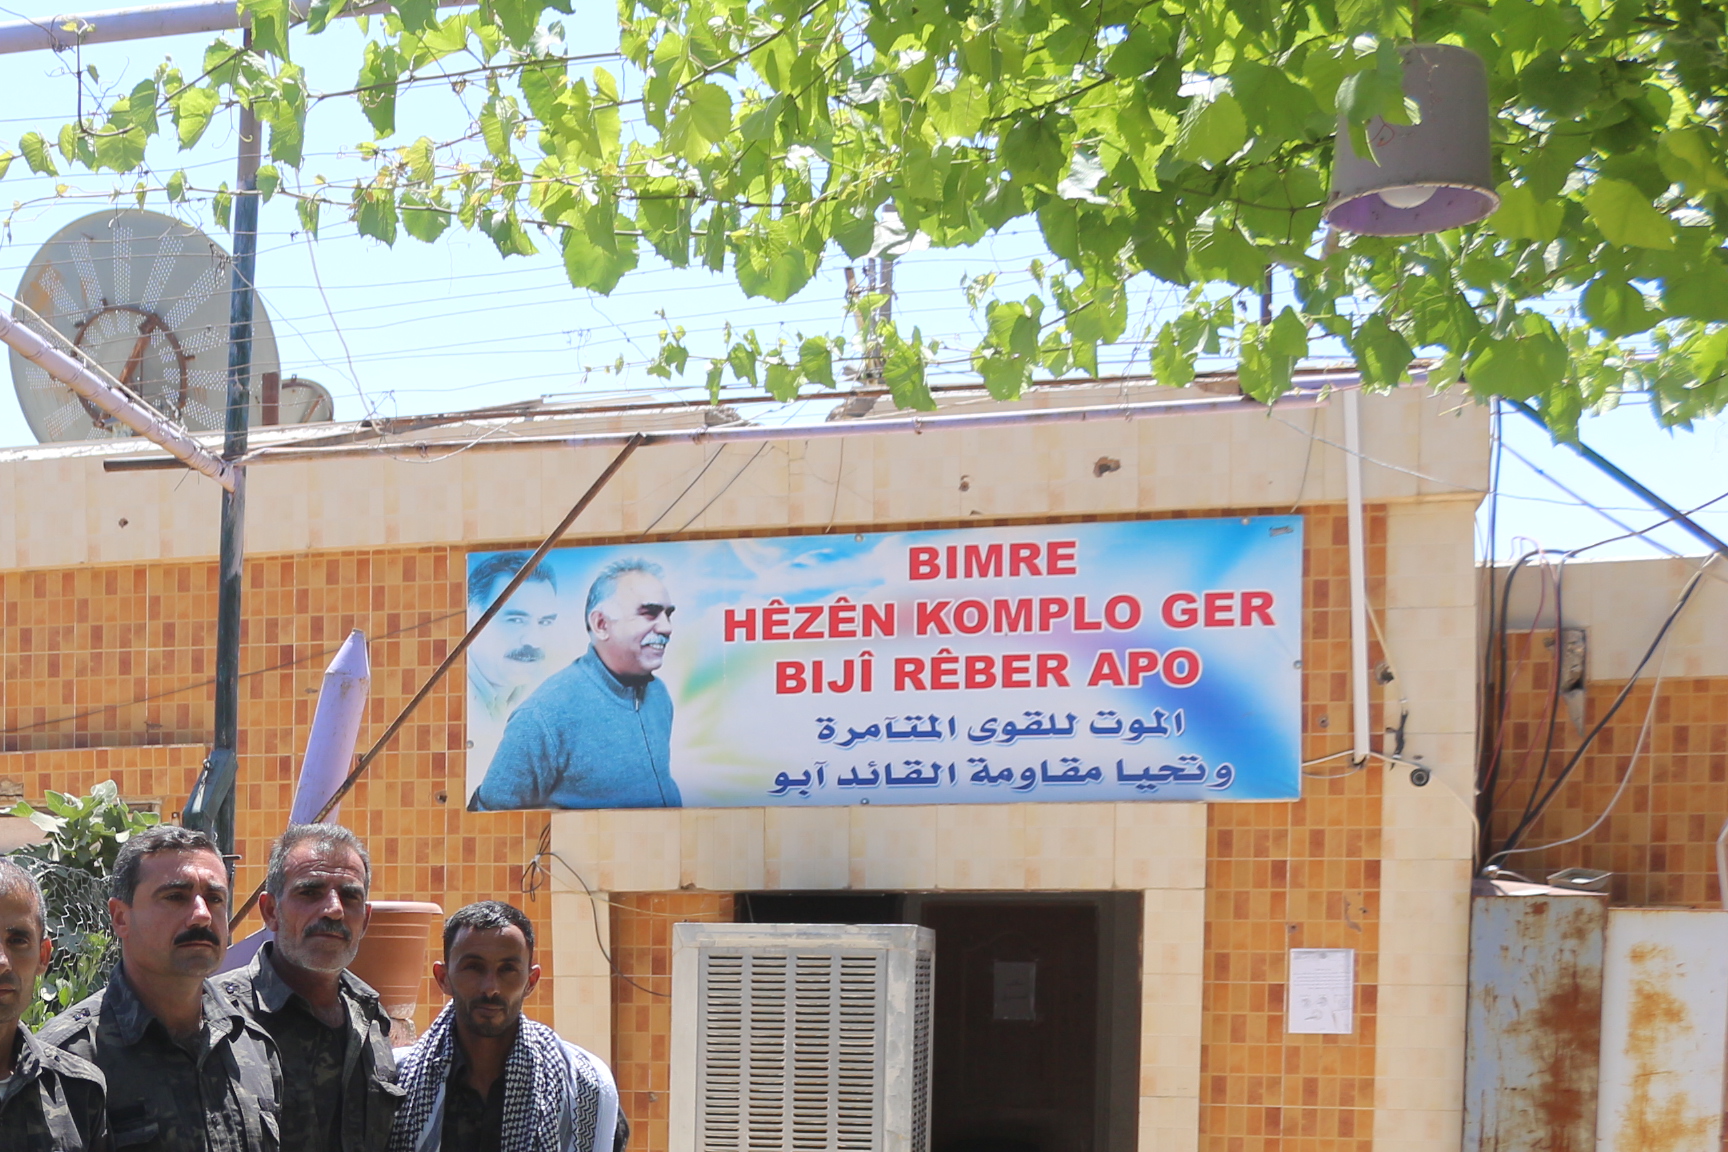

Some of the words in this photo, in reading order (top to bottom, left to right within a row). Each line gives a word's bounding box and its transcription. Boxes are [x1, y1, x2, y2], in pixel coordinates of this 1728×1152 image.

[909, 540, 1077, 581] BIMRE
[725, 597, 896, 642] HÊZÊN
[917, 595, 1142, 636] KOMPLO
[1162, 590, 1275, 629] GER
[776, 651, 874, 695] BIJÎ
[894, 648, 1069, 691] RÊBER
[1088, 649, 1200, 687] APO
[967, 711, 1077, 744] للقوى
[1089, 708, 1187, 741] الموت
[837, 760, 956, 791] القائد
[968, 757, 1103, 791] مقاومة
[1116, 755, 1236, 792] وتحيا
